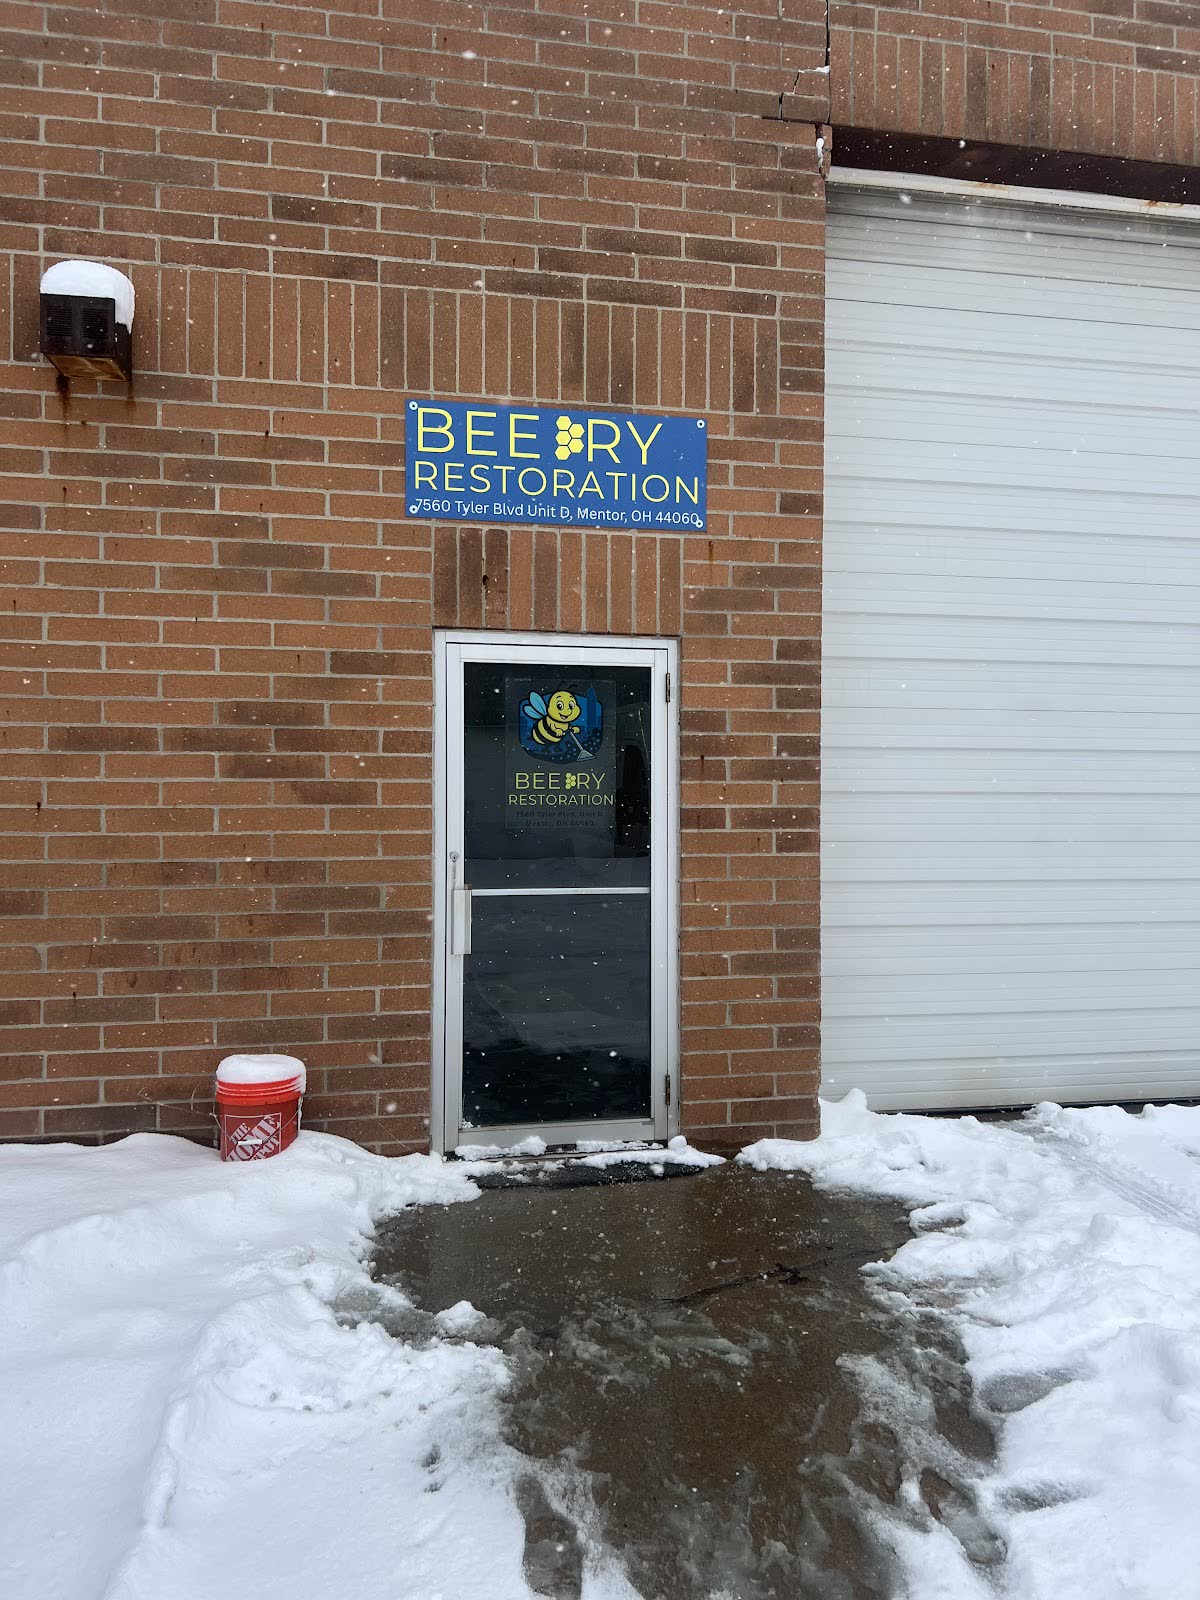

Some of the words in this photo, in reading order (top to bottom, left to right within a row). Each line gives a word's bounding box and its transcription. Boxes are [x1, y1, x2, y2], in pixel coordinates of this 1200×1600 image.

[414, 460, 699, 505] RESTORATION
[415, 498, 451, 513] 7560
[455, 501, 489, 516] Tyler
[493, 502, 523, 516] Blvd
[527, 505, 556, 518] Unit
[577, 508, 628, 523] Mentor,
[631, 510, 651, 523] OH
[655, 511, 699, 525] 44060
[508, 794, 614, 806] RESTORATION
[229, 1122, 251, 1145] THE
